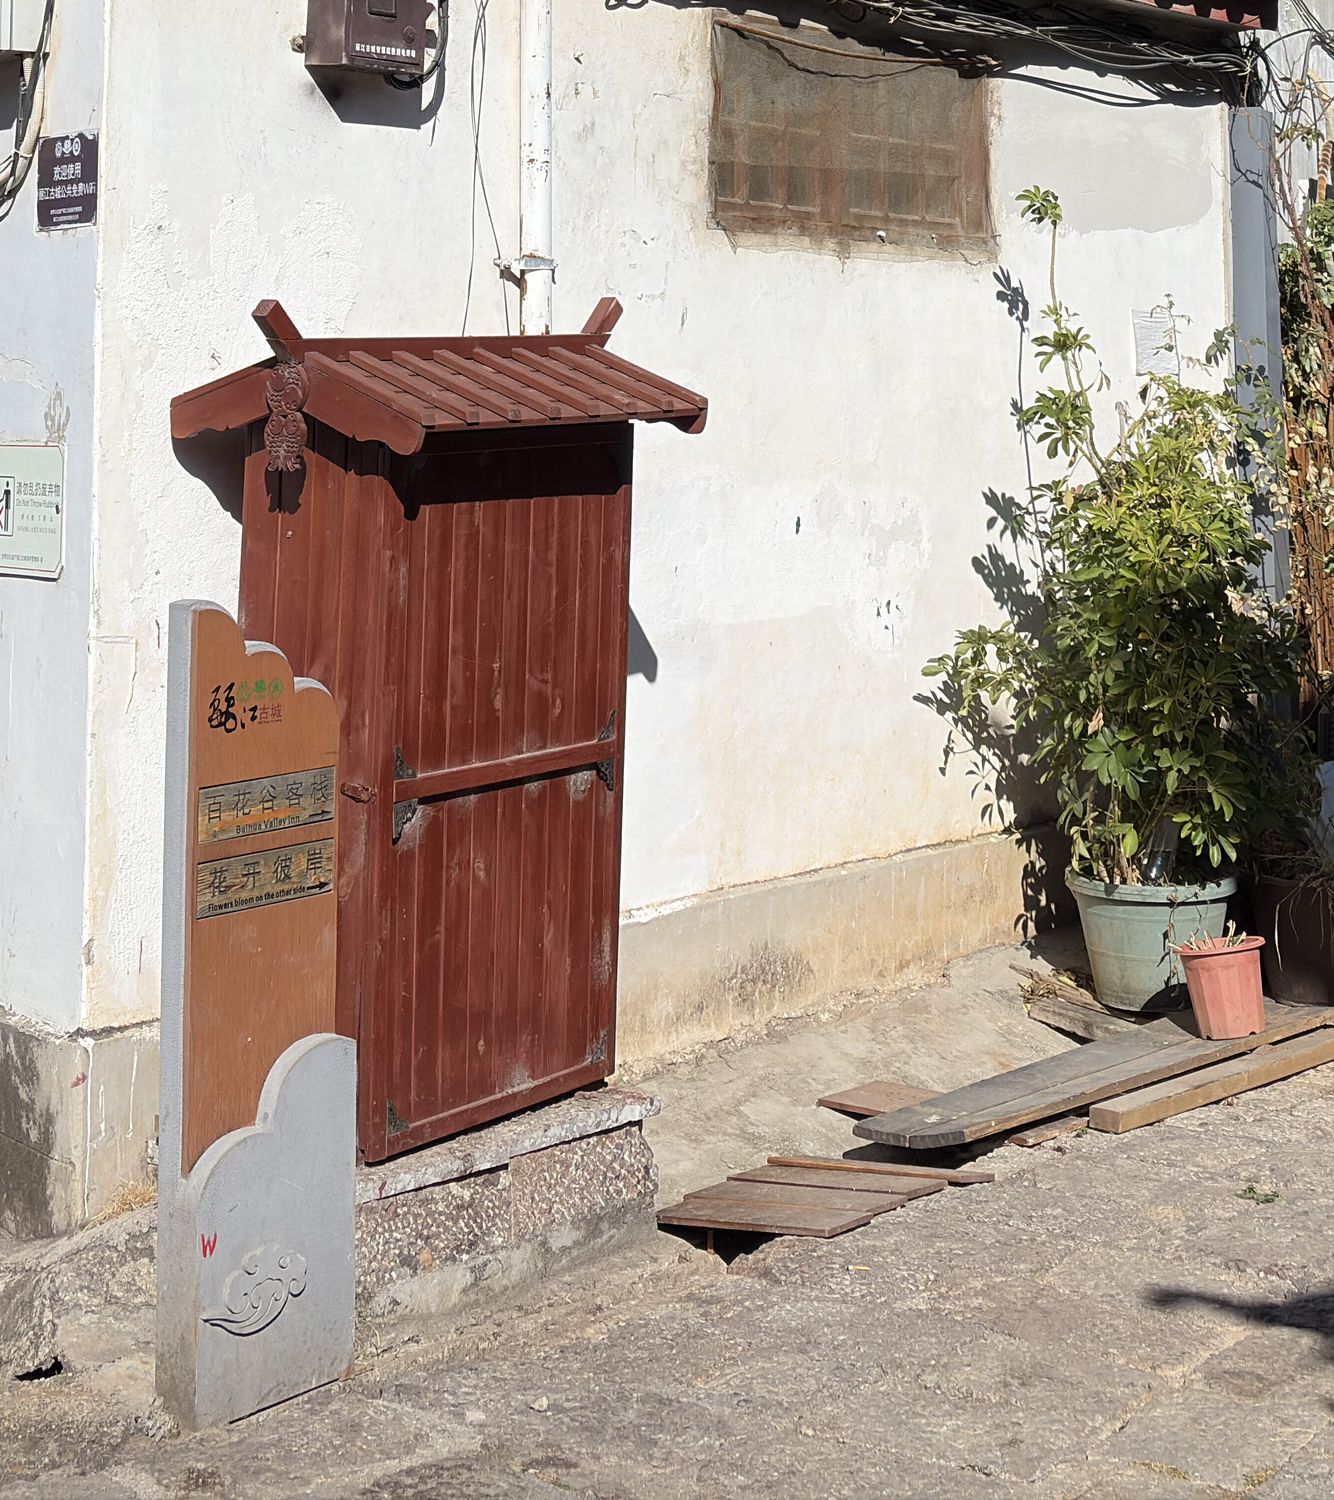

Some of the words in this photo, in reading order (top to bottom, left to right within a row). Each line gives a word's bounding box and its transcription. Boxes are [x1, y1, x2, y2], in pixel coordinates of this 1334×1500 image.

[53, 162, 82, 181] 欢迎使用
[205, 774, 329, 824] 百花谷客栈
[264, 817, 286, 829] Valley
[208, 847, 324, 899] 花开彼岸
[208, 901, 234, 912] Flowers
[234, 897, 255, 907] bloom
[255, 895, 264, 903] on
[264, 892, 275, 901] the
[275, 888, 292, 898] other
[293, 885, 306, 894] side
[201, 1232, 218, 1259] W
